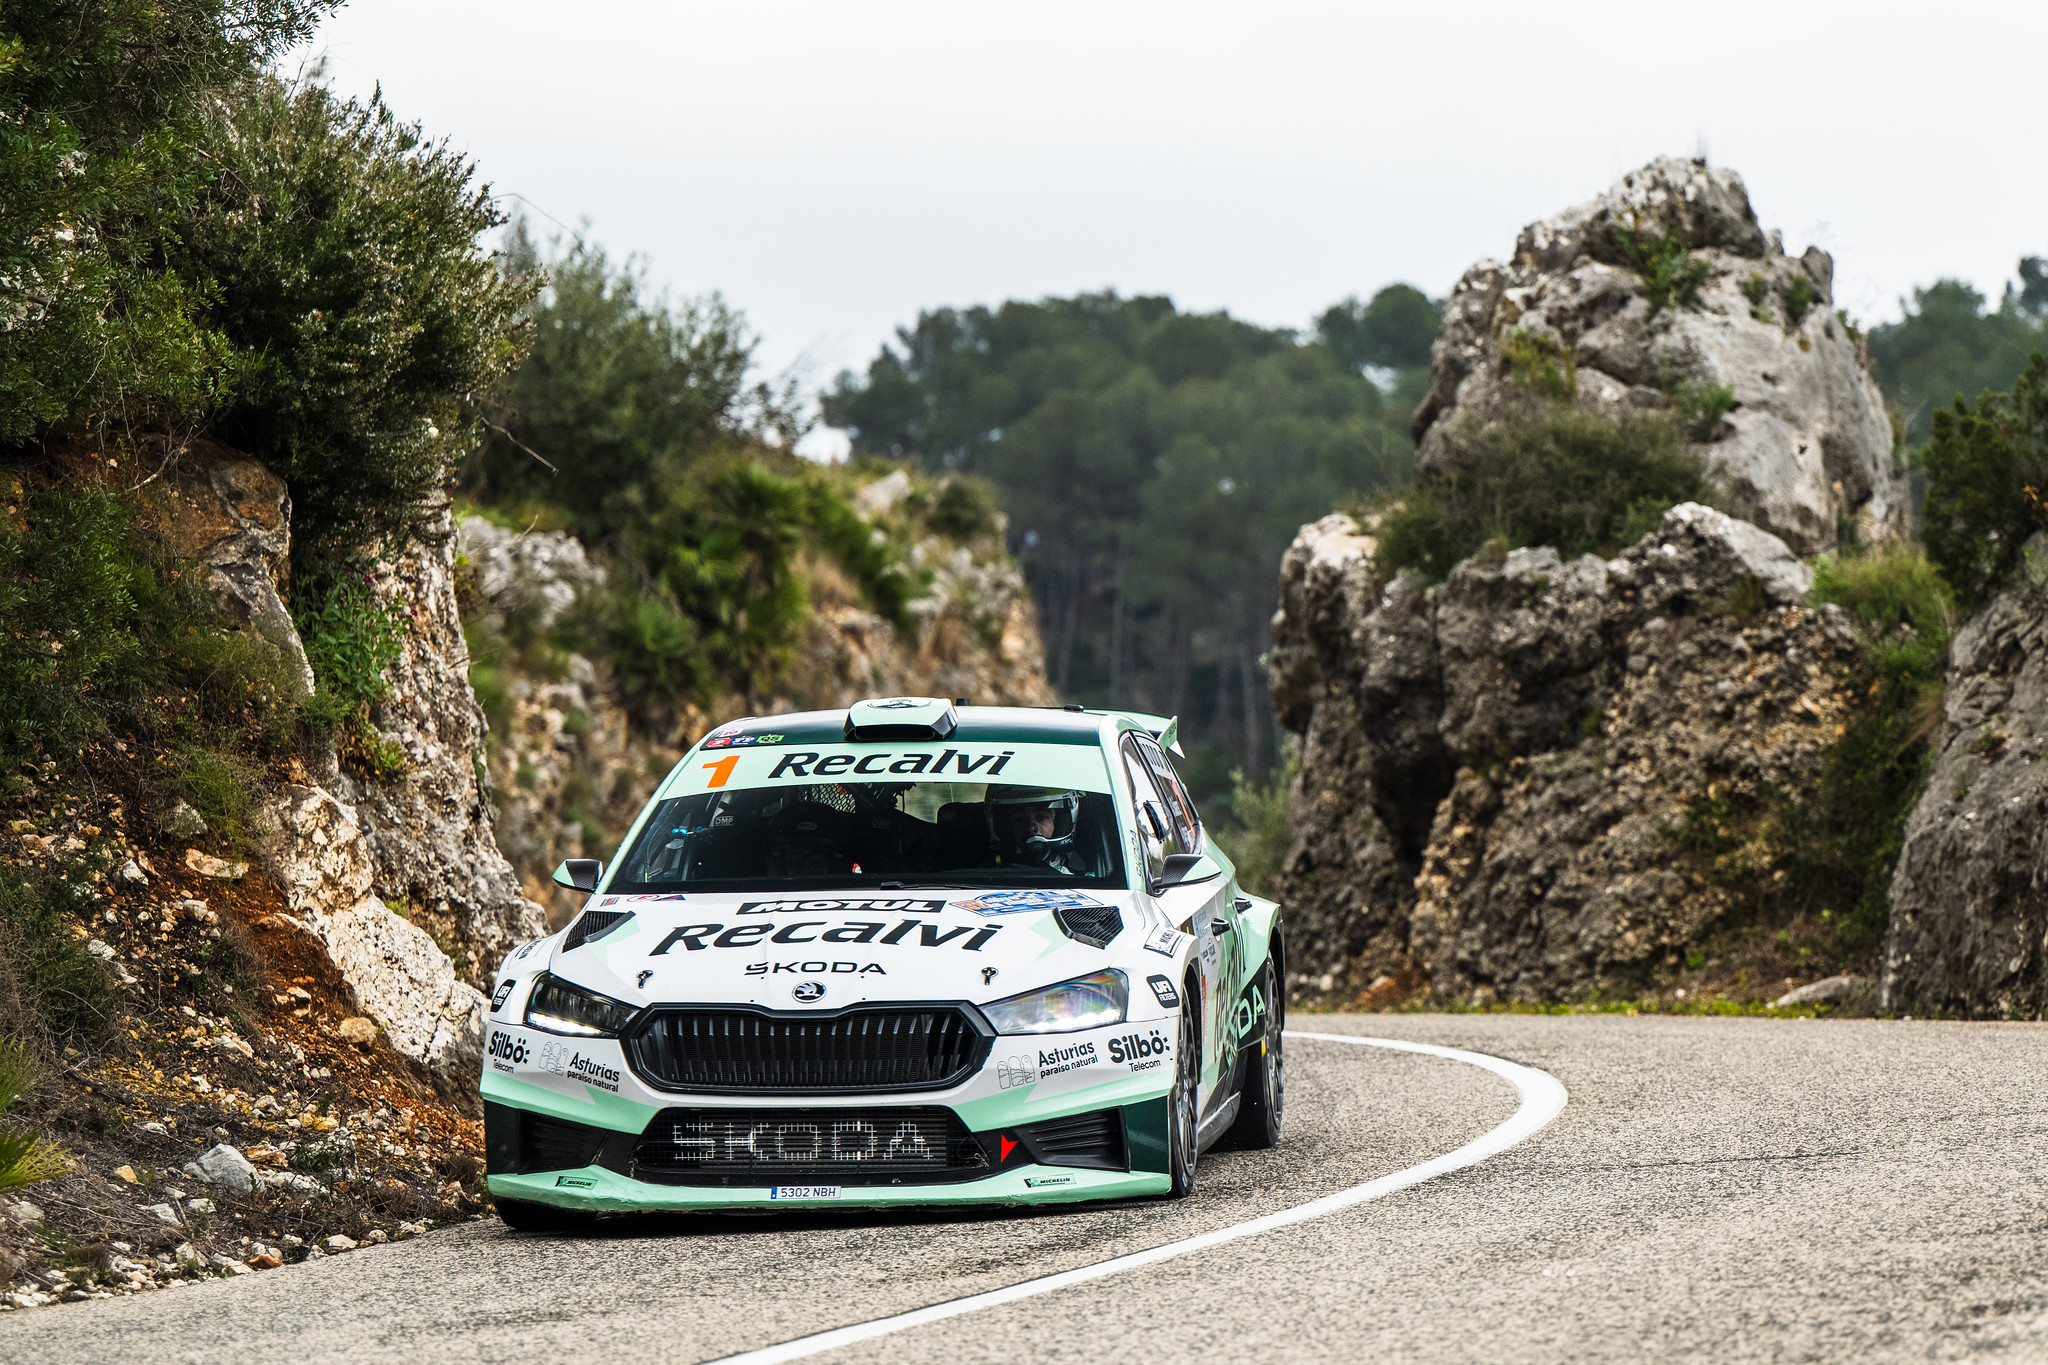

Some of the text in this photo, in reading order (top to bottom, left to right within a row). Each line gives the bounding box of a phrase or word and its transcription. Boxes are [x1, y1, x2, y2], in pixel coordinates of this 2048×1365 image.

[701, 755, 741, 789] 1
[767, 748, 1016, 780] Recalvi
[715, 816, 734, 825] OMP
[745, 899, 936, 913] MOTUL
[648, 918, 1004, 957] Recalvi
[1038, 1042, 1095, 1068] Asturias
[1071, 1054, 1099, 1070] natural
[492, 1058, 515, 1074] Telecom
[568, 1051, 621, 1083] Asturias
[1129, 1058, 1161, 1073] Telecom
[592, 1078, 619, 1093] natural
[566, 1179, 593, 1187] MICHELIN
[780, 1187, 836, 1198] 5302 NBH
